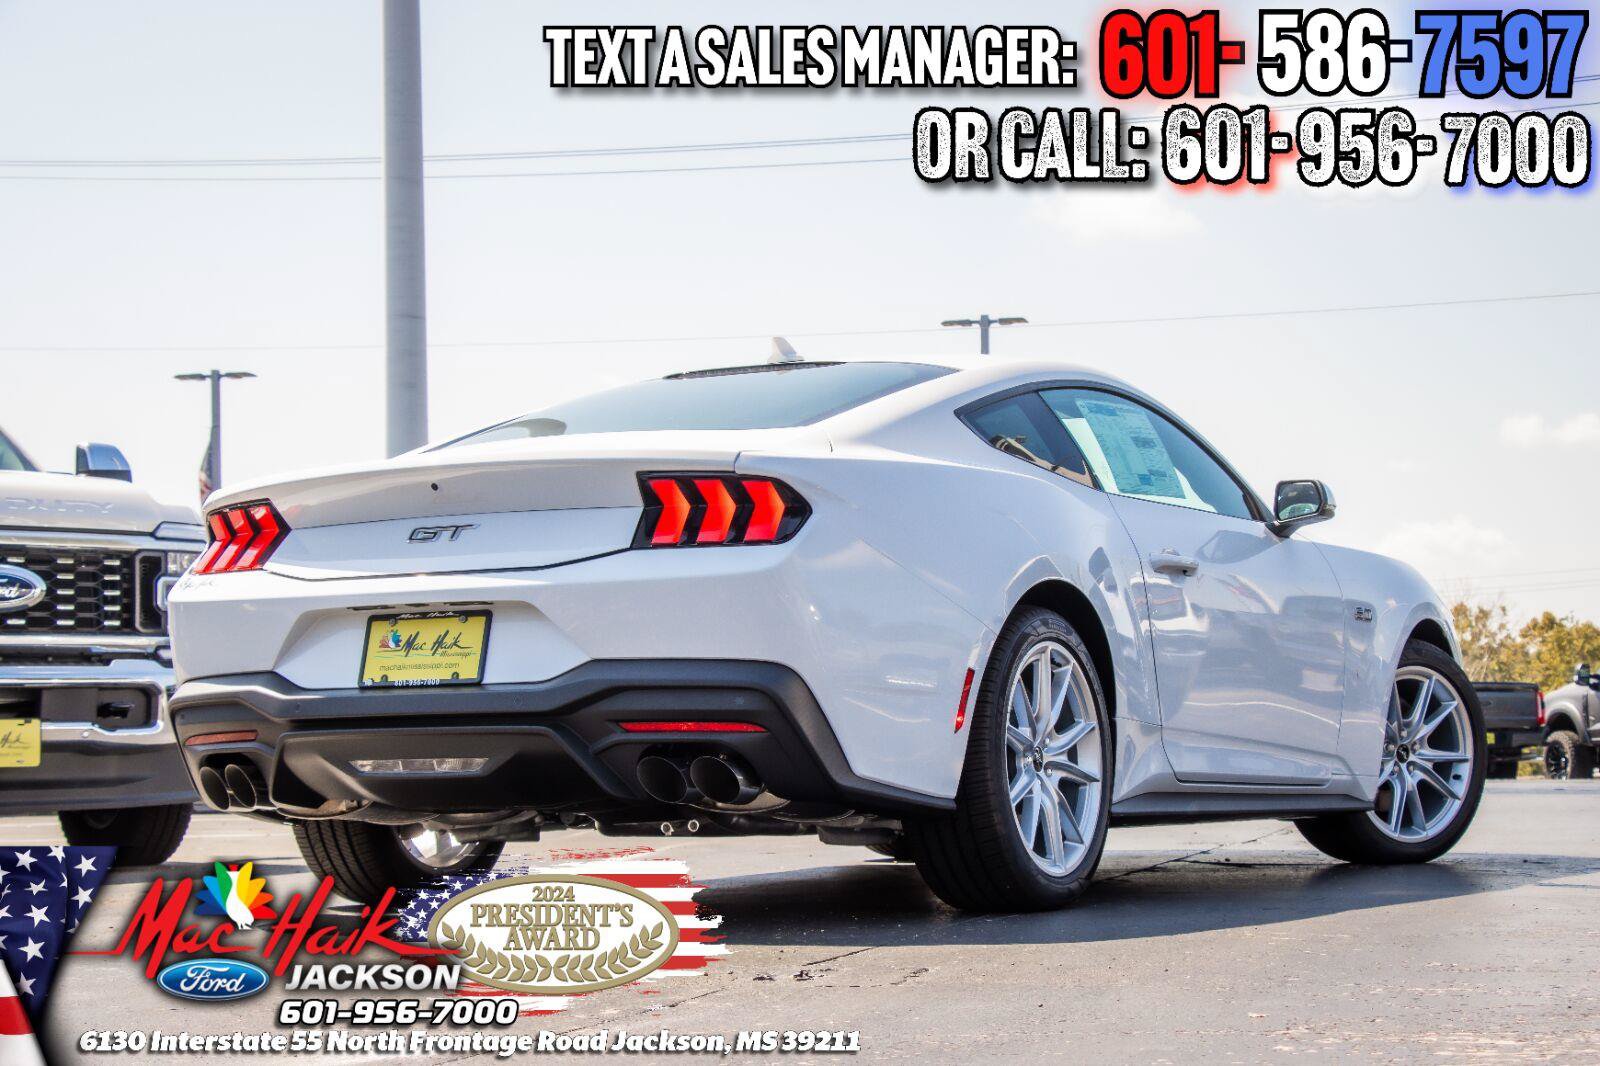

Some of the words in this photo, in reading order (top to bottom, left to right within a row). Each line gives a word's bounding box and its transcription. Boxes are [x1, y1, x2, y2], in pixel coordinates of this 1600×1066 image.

[407, 524, 479, 543] GT
[400, 631, 427, 657] Mac
[430, 629, 473, 656] Haik
